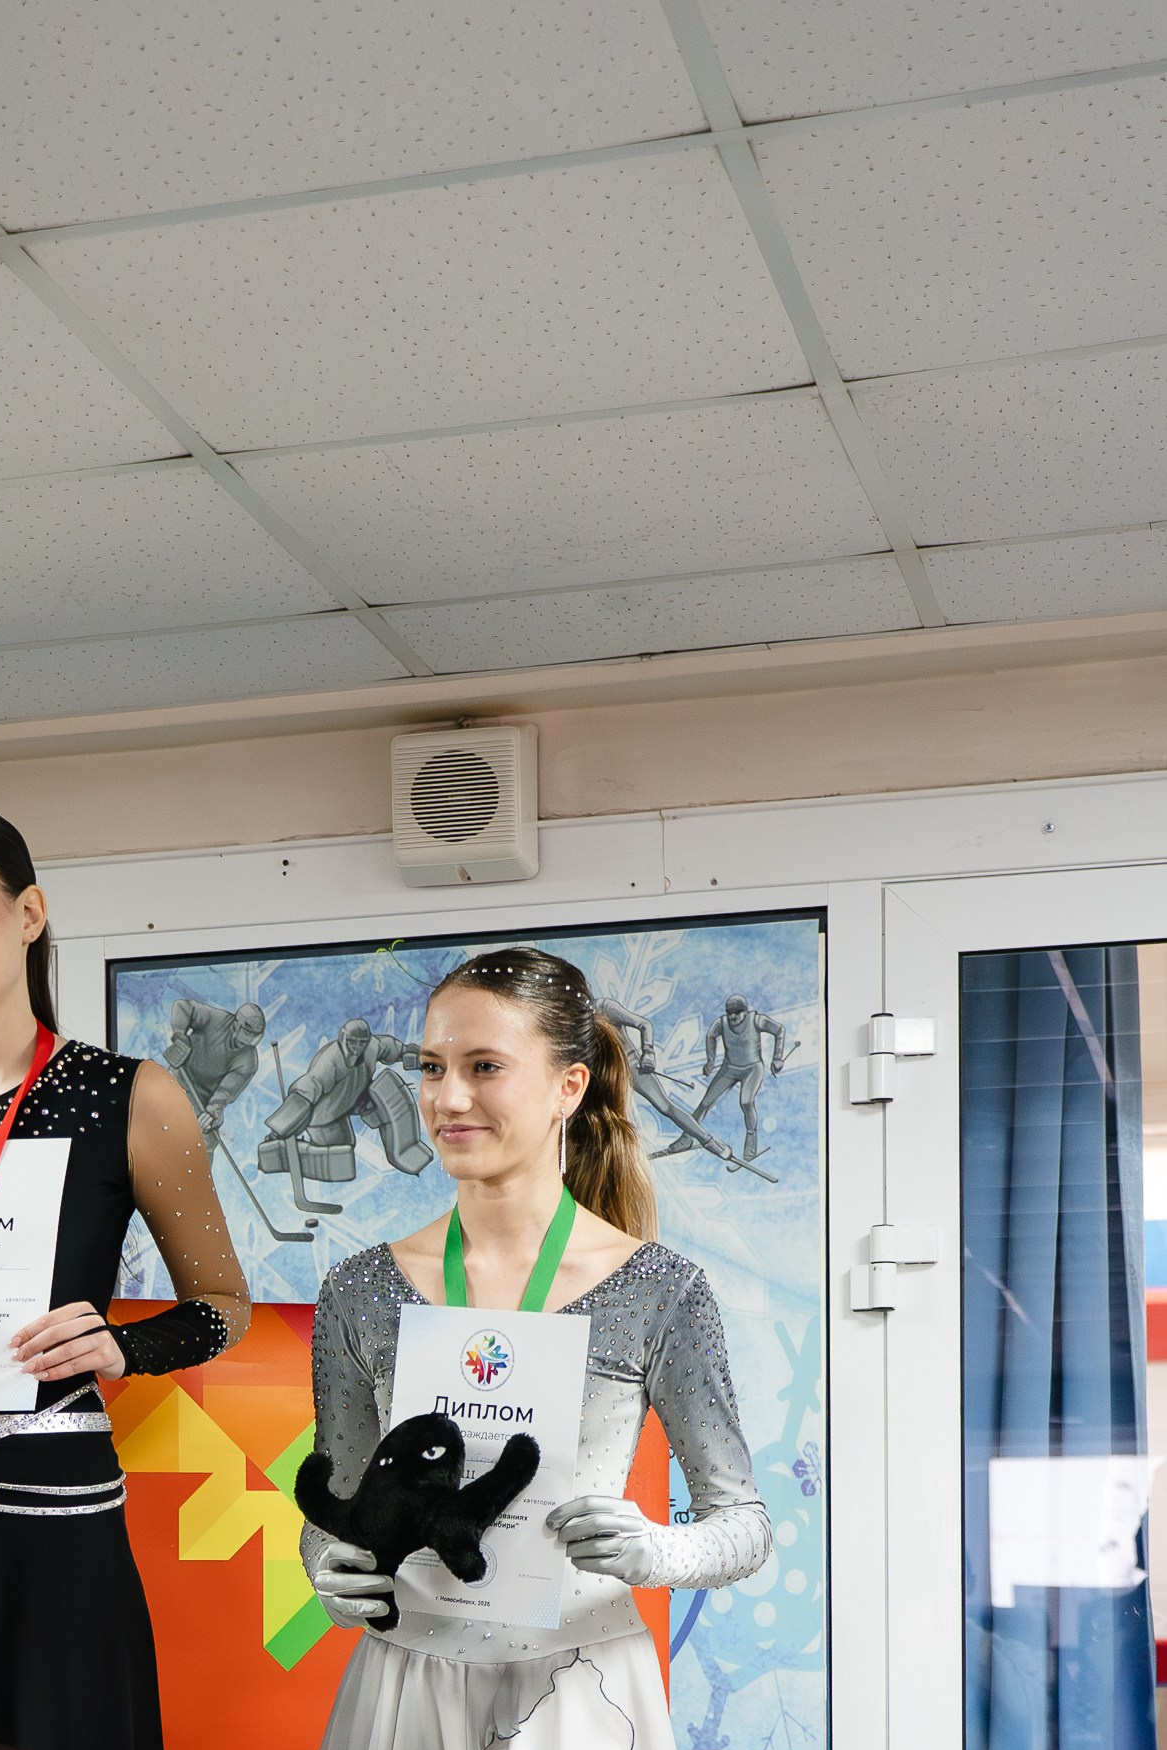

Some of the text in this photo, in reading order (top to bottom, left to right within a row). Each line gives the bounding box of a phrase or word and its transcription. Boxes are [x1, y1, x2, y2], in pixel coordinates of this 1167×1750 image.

[434, 1395, 534, 1424] Диплом
[523, 1498, 556, 1506] категории
[494, 1520, 520, 1530] ибири"
